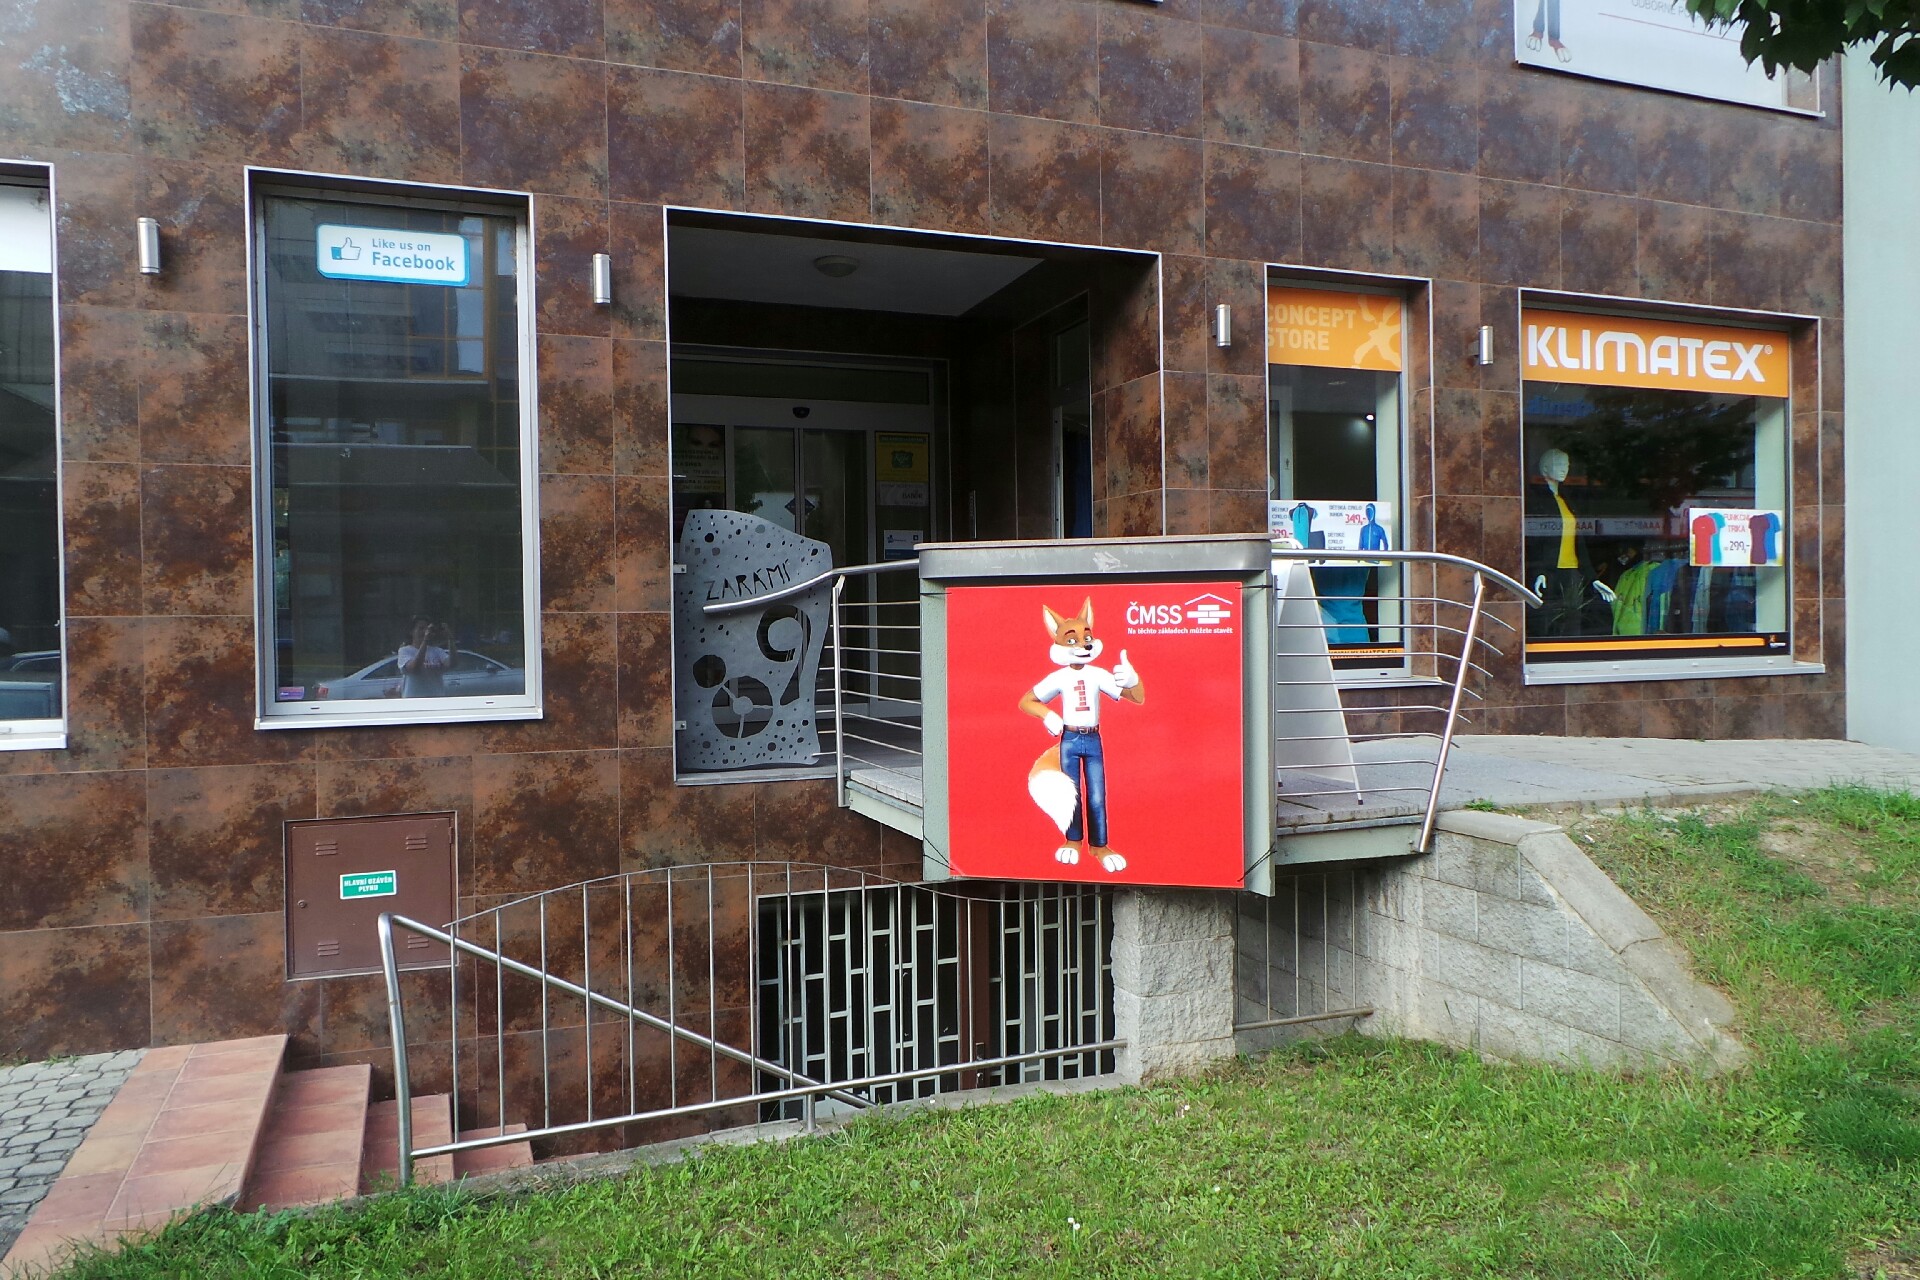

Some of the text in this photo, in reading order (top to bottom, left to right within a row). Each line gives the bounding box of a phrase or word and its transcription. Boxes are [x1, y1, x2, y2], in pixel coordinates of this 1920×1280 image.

[371, 238, 431, 252] Like us on
[371, 251, 455, 271] Facebook
[1126, 601, 1183, 625] ČMSS
[1127, 627, 1136, 635] Na
[1137, 627, 1157, 635] těchto
[1213, 626, 1233, 634] stavět
[358, 884, 378, 892] PLYNU
